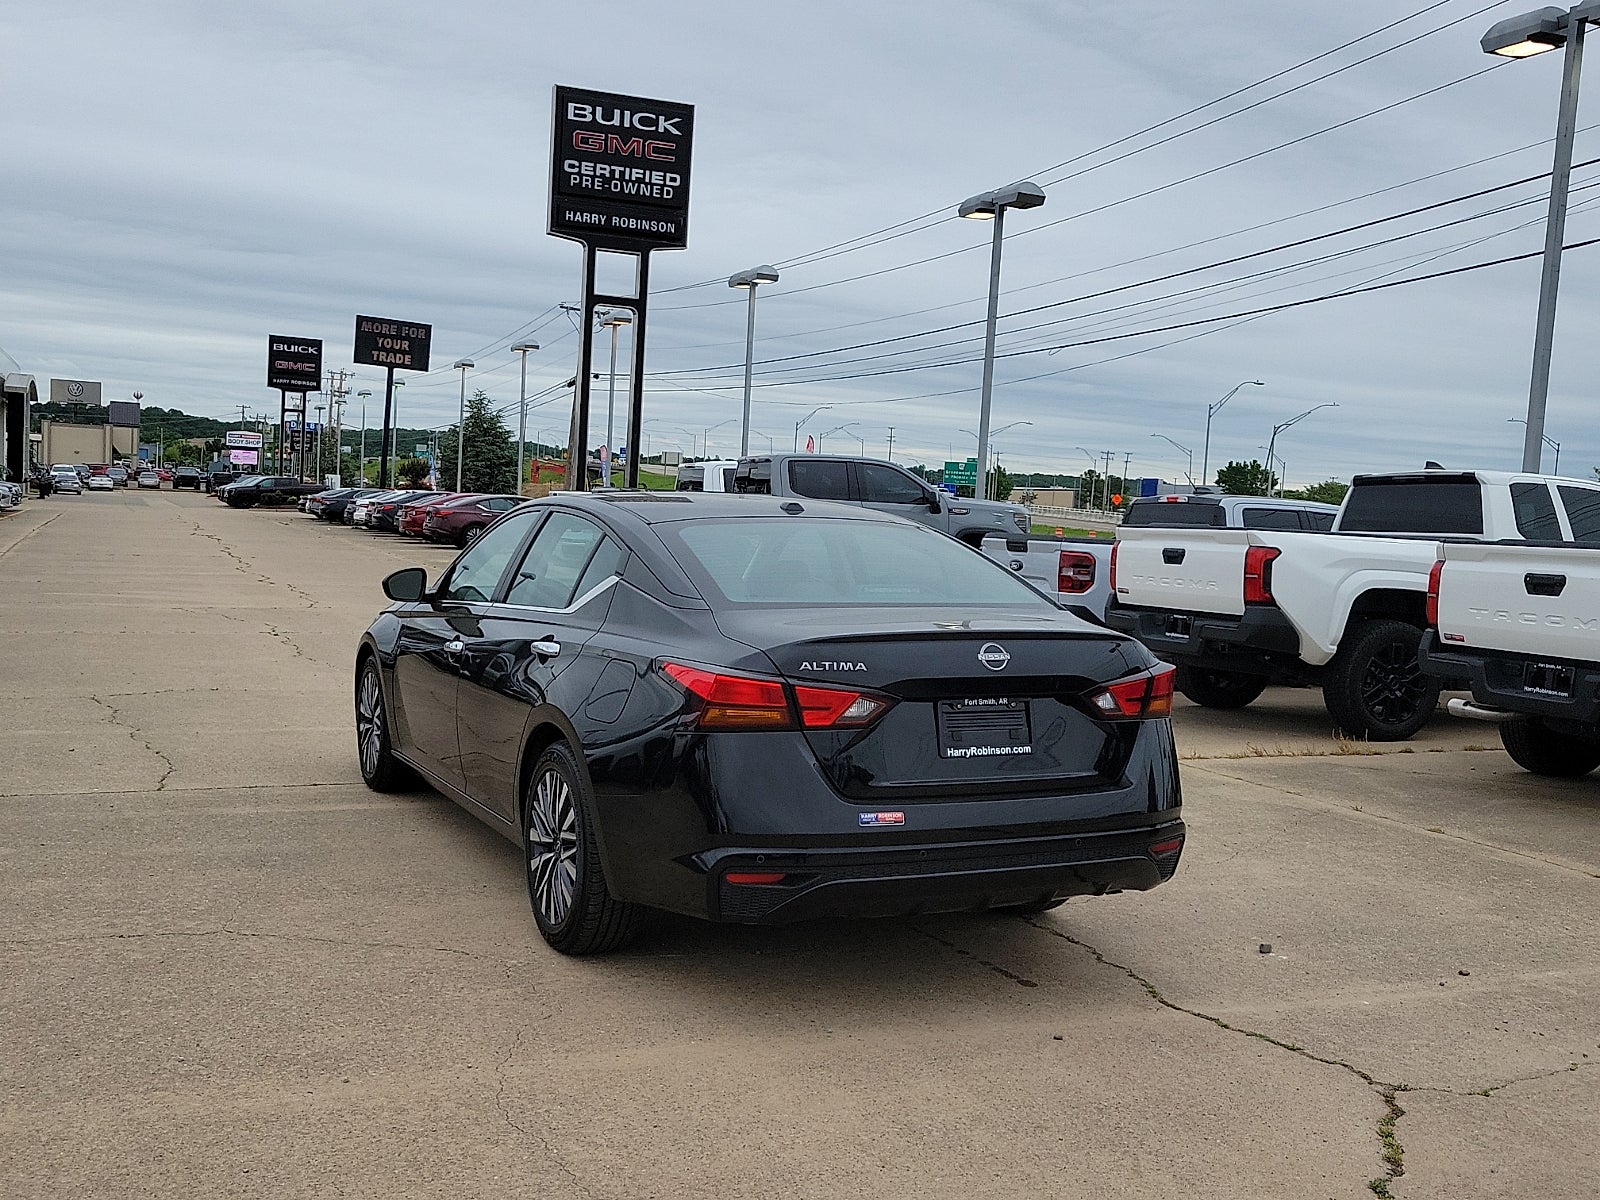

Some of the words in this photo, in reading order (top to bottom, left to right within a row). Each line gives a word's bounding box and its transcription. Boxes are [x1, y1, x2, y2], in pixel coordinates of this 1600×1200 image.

[567, 102, 683, 136] BUICK
[572, 129, 676, 162] GMC
[563, 159, 681, 187] CERTIFIED
[570, 174, 673, 199] PRE-OWNED
[565, 210, 607, 226] HARRY
[611, 215, 675, 233] ROBINSON
[361, 320, 398, 335] MORE
[401, 325, 426, 339] FOR
[273, 343, 319, 355] BUICK
[376, 336, 410, 351] YOUR
[371, 350, 412, 365] TRADE
[274, 360, 316, 372] GMC
[1132, 574, 1219, 591] TACOMA
[977, 653, 1011, 661] NISSAN
[799, 661, 868, 672] ALTIMA
[964, 698, 978, 706] Fort
[978, 698, 998, 706] Smith,
[998, 697, 1009, 705] AR
[947, 745, 1032, 758] HarryRobinson.com
